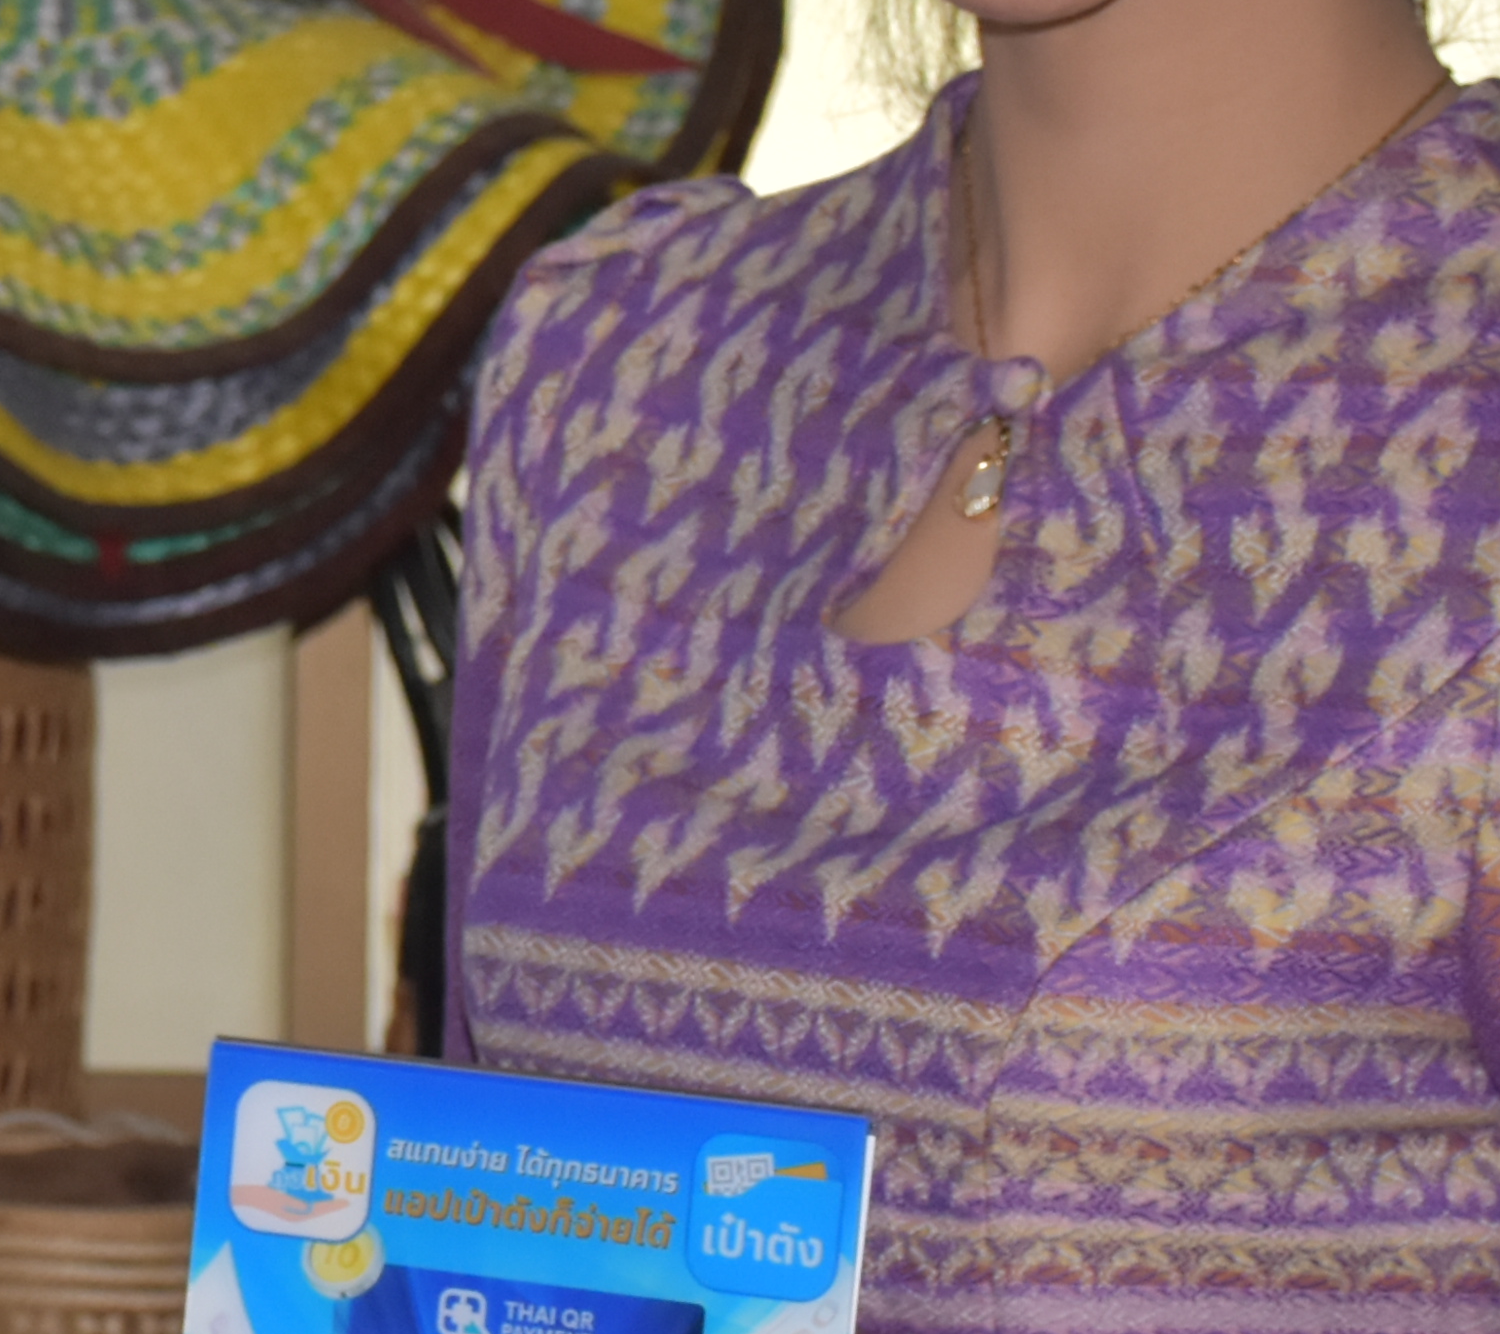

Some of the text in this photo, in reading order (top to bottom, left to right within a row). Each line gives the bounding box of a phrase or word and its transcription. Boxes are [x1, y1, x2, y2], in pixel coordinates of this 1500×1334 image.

[387, 1137, 680, 1195] สแกนง่าย ได้ทุกธนาคาร
[703, 1212, 824, 1268] เป๋าตัง
[503, 1300, 595, 1332] THAI QR
